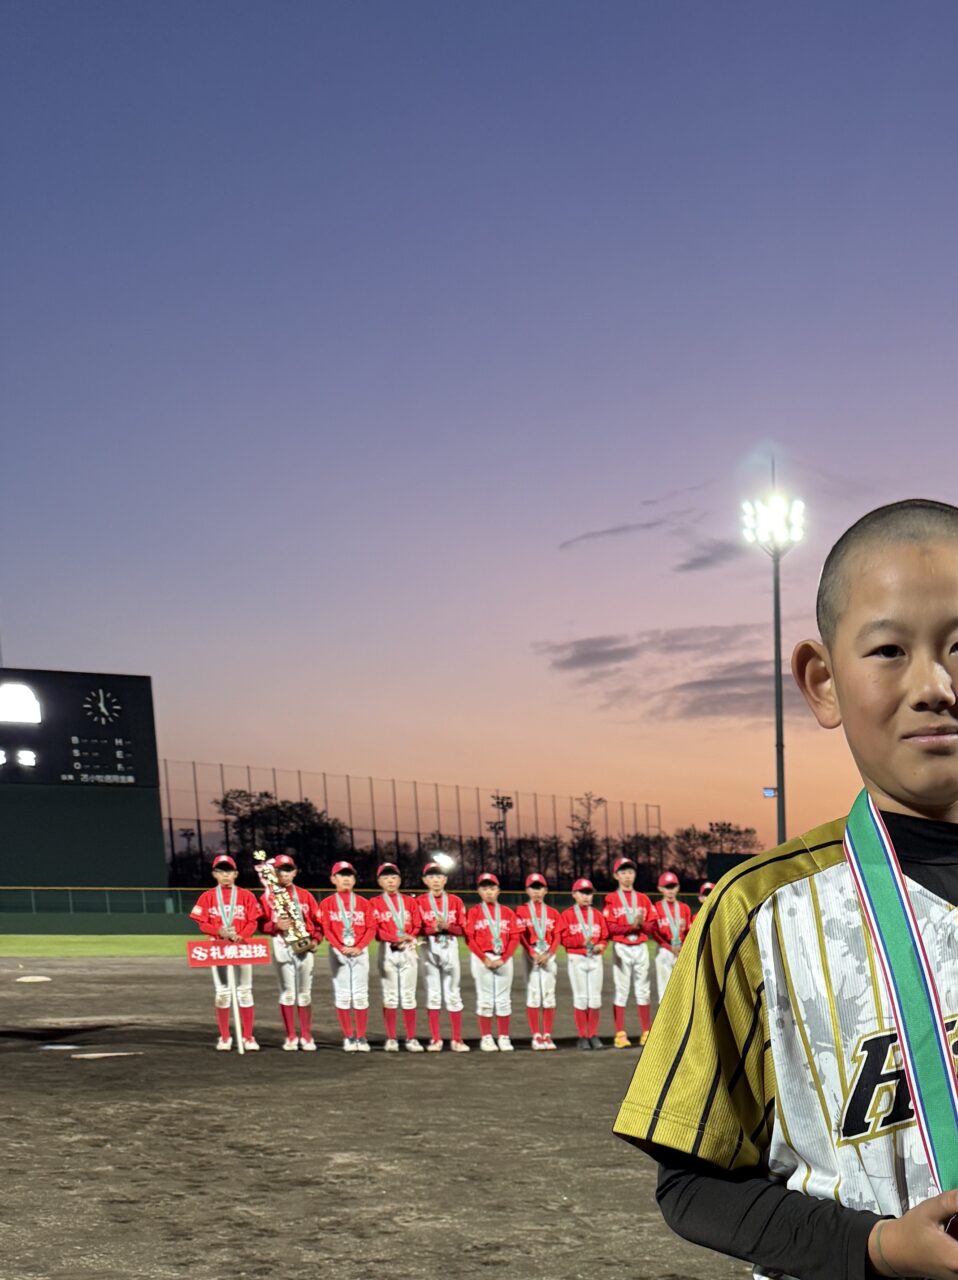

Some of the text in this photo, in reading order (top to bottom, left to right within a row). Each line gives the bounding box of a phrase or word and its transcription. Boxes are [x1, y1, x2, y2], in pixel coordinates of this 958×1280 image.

[114, 738, 123, 746] H
[116, 750, 124, 759] E
[210, 944, 268, 959] 札幌選抜
